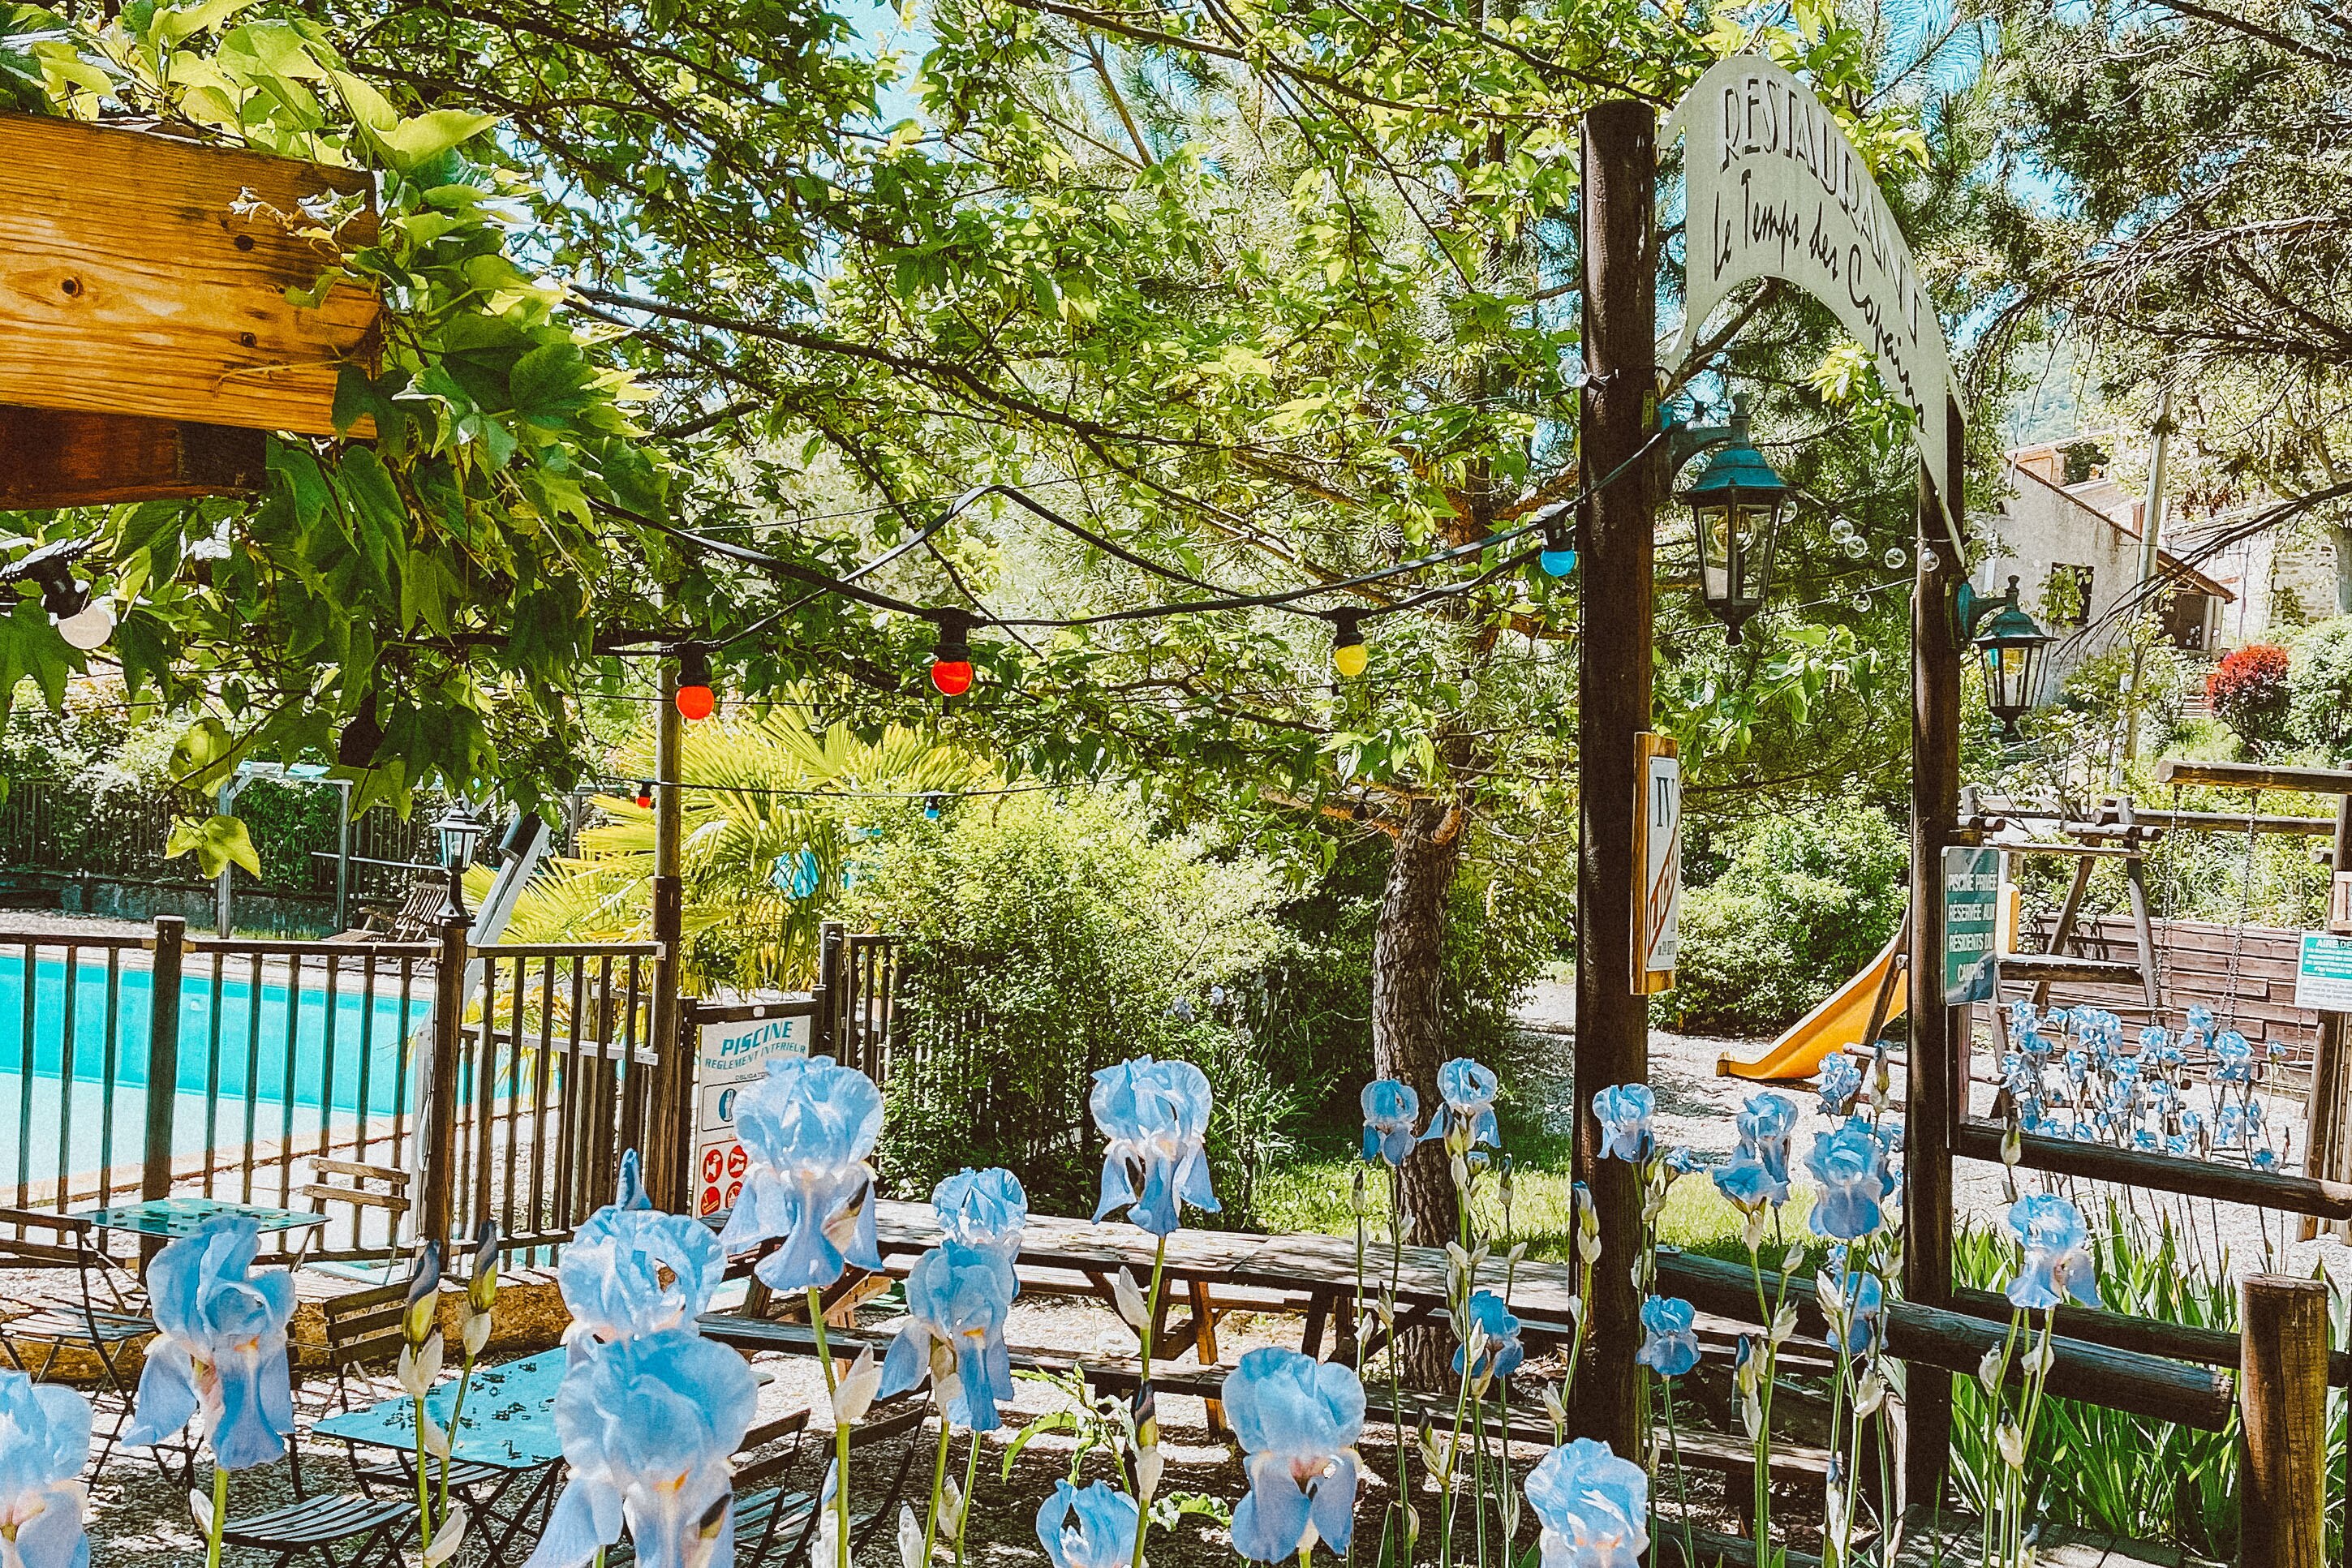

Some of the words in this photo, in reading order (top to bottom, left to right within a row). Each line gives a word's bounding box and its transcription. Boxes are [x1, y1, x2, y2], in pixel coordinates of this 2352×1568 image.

[1719, 79, 1923, 349] RESTAURANT
[1741, 169, 1800, 273] Temps
[1809, 200, 1838, 281] des
[1656, 777, 1675, 828] IV
[1948, 874, 1974, 891] PISCINE
[1976, 870, 1997, 891] PRIVÉE
[1948, 899, 1982, 922] RÉSERVÉE
[1949, 930, 1984, 952] RÉSIDENTS
[1984, 933, 1994, 950] DU
[2315, 939, 2338, 949] AIRE
[1957, 962, 1985, 982] CAMPING
[720, 1021, 793, 1056] PISCINE
[704, 1050, 759, 1070] REGLEMENT
[761, 1042, 806, 1057] INTERIEUR
